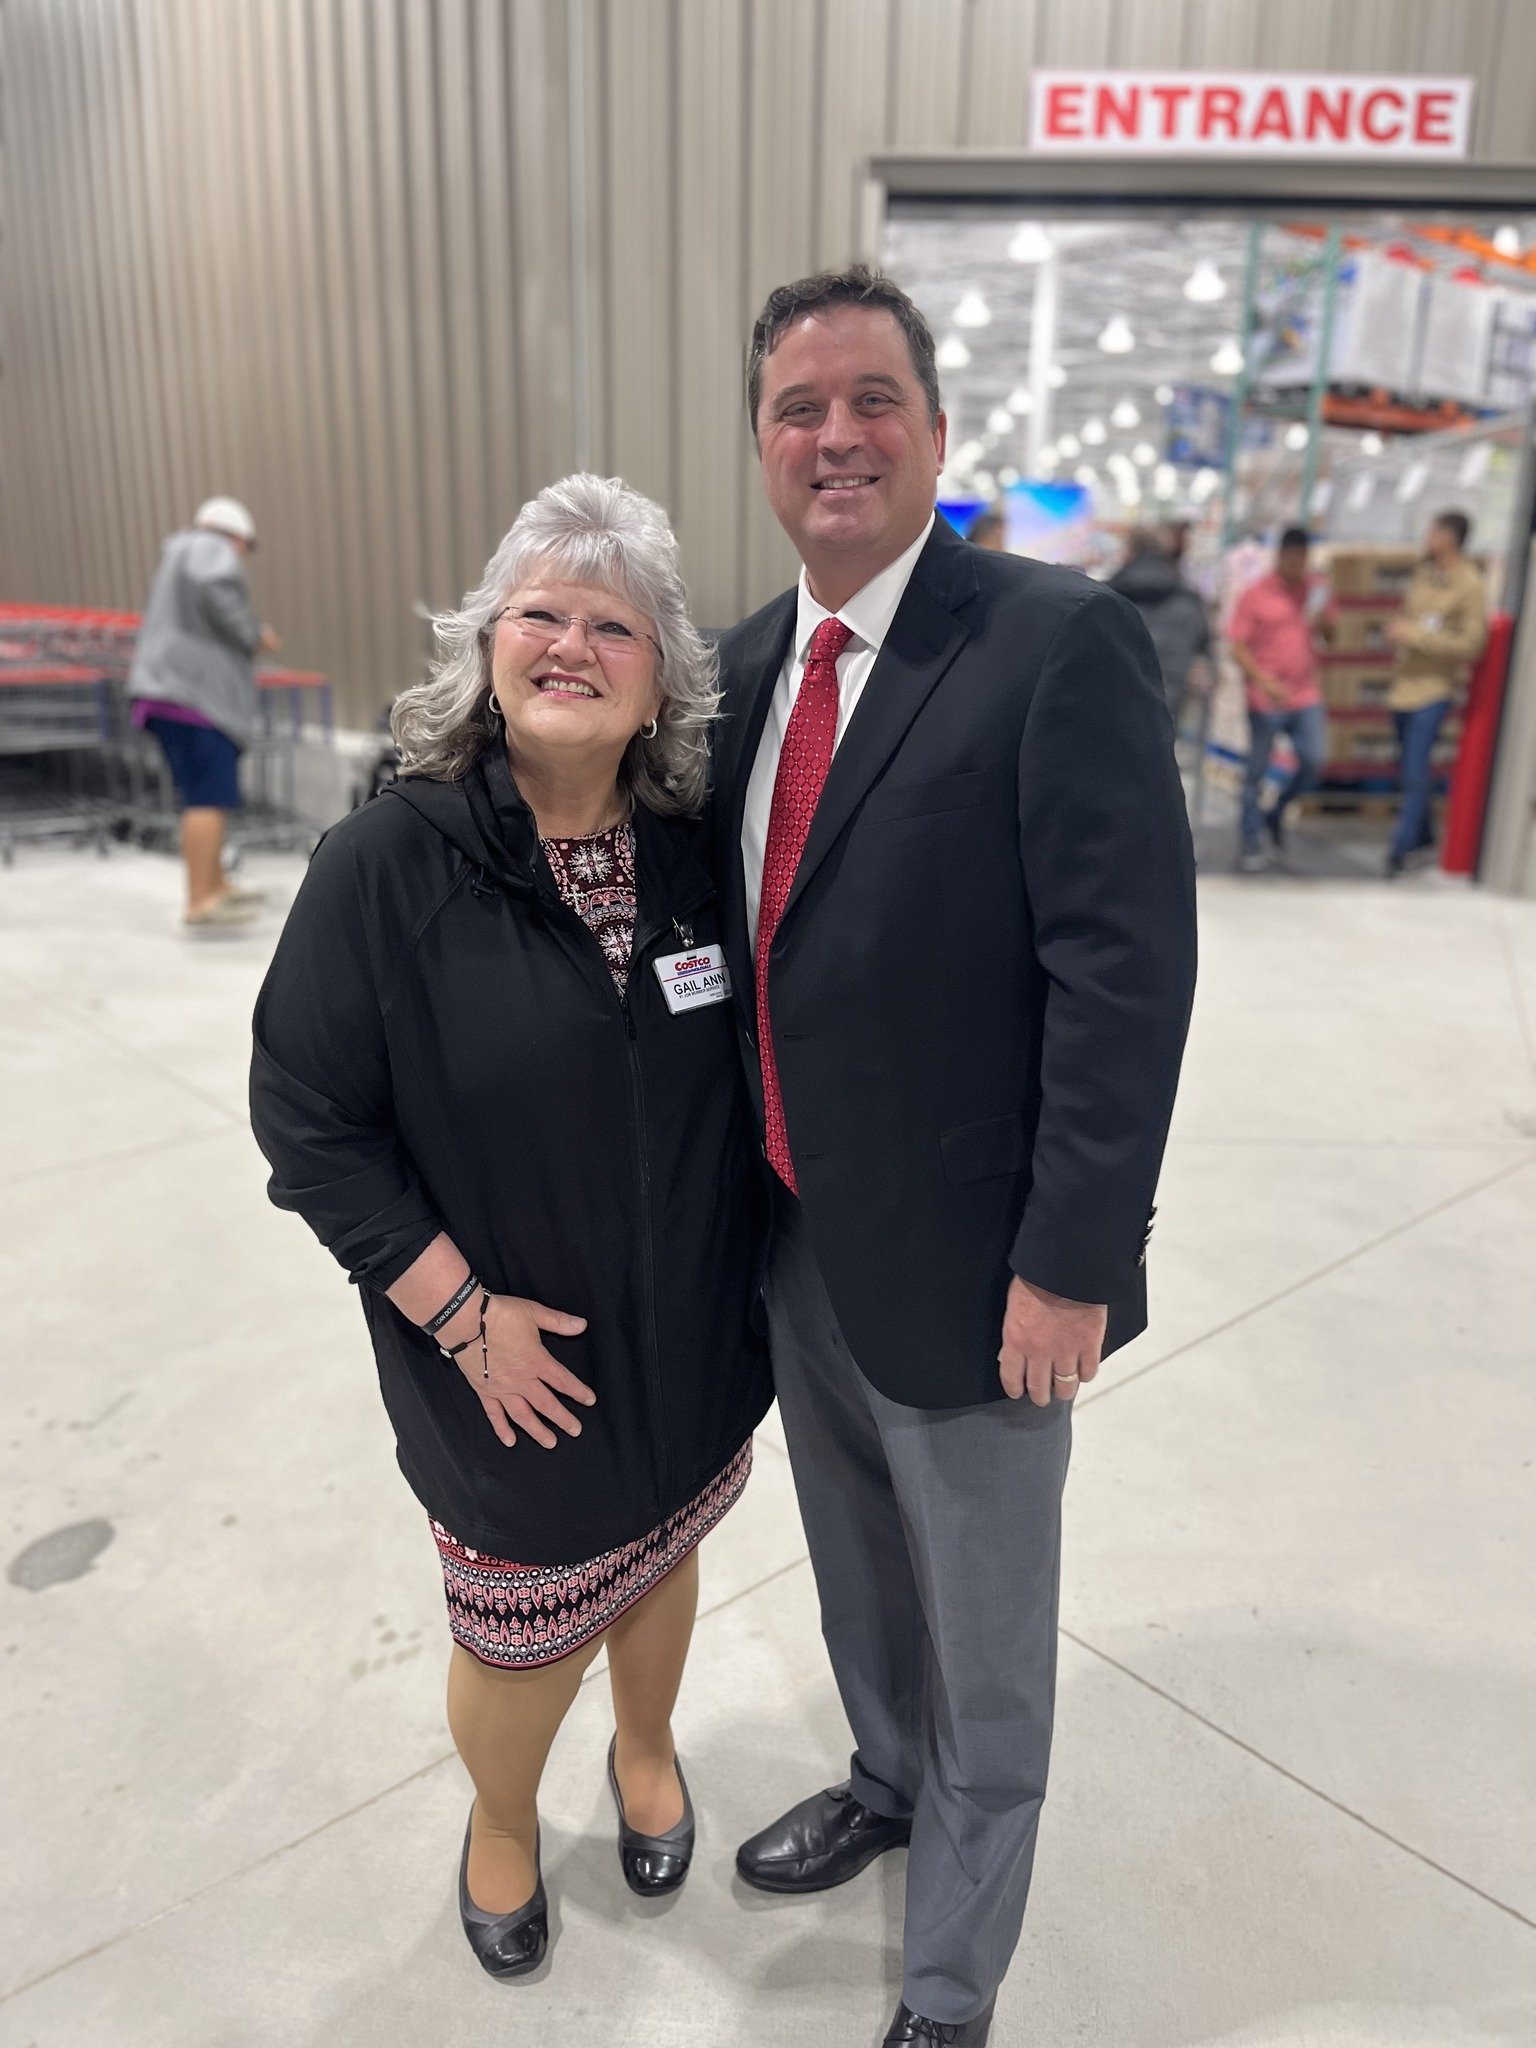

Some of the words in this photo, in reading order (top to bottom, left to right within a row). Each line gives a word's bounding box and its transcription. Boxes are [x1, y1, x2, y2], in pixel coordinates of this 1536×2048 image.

[1045, 84, 1457, 145] ENTRANCE
[675, 957, 710, 971] COSTCO
[674, 980, 701, 995] GAIL
[703, 973, 726, 988] ANN
[444, 1308, 452, 1316] DO
